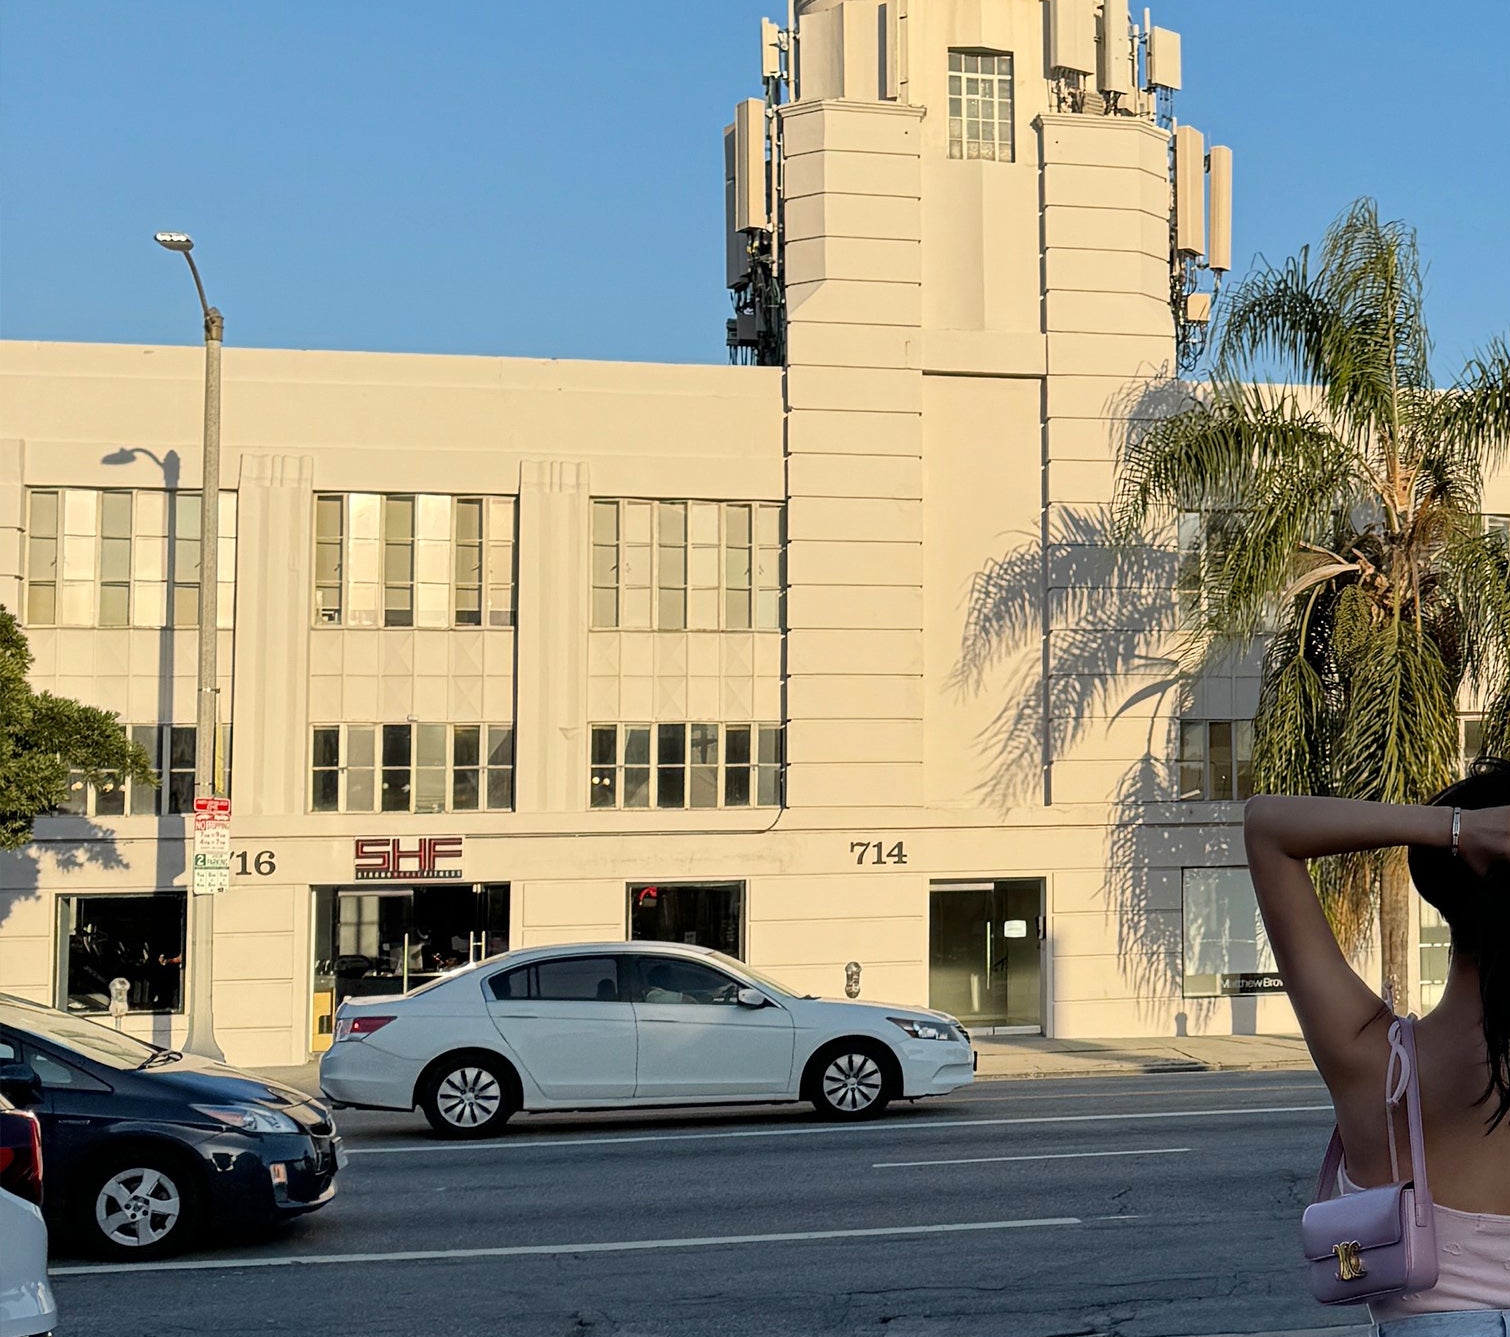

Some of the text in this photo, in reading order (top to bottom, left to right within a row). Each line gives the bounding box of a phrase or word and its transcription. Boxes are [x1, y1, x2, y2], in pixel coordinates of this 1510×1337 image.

[229, 850, 276, 876] 16
[355, 838, 463, 872] SHF
[850, 841, 908, 865] 714
